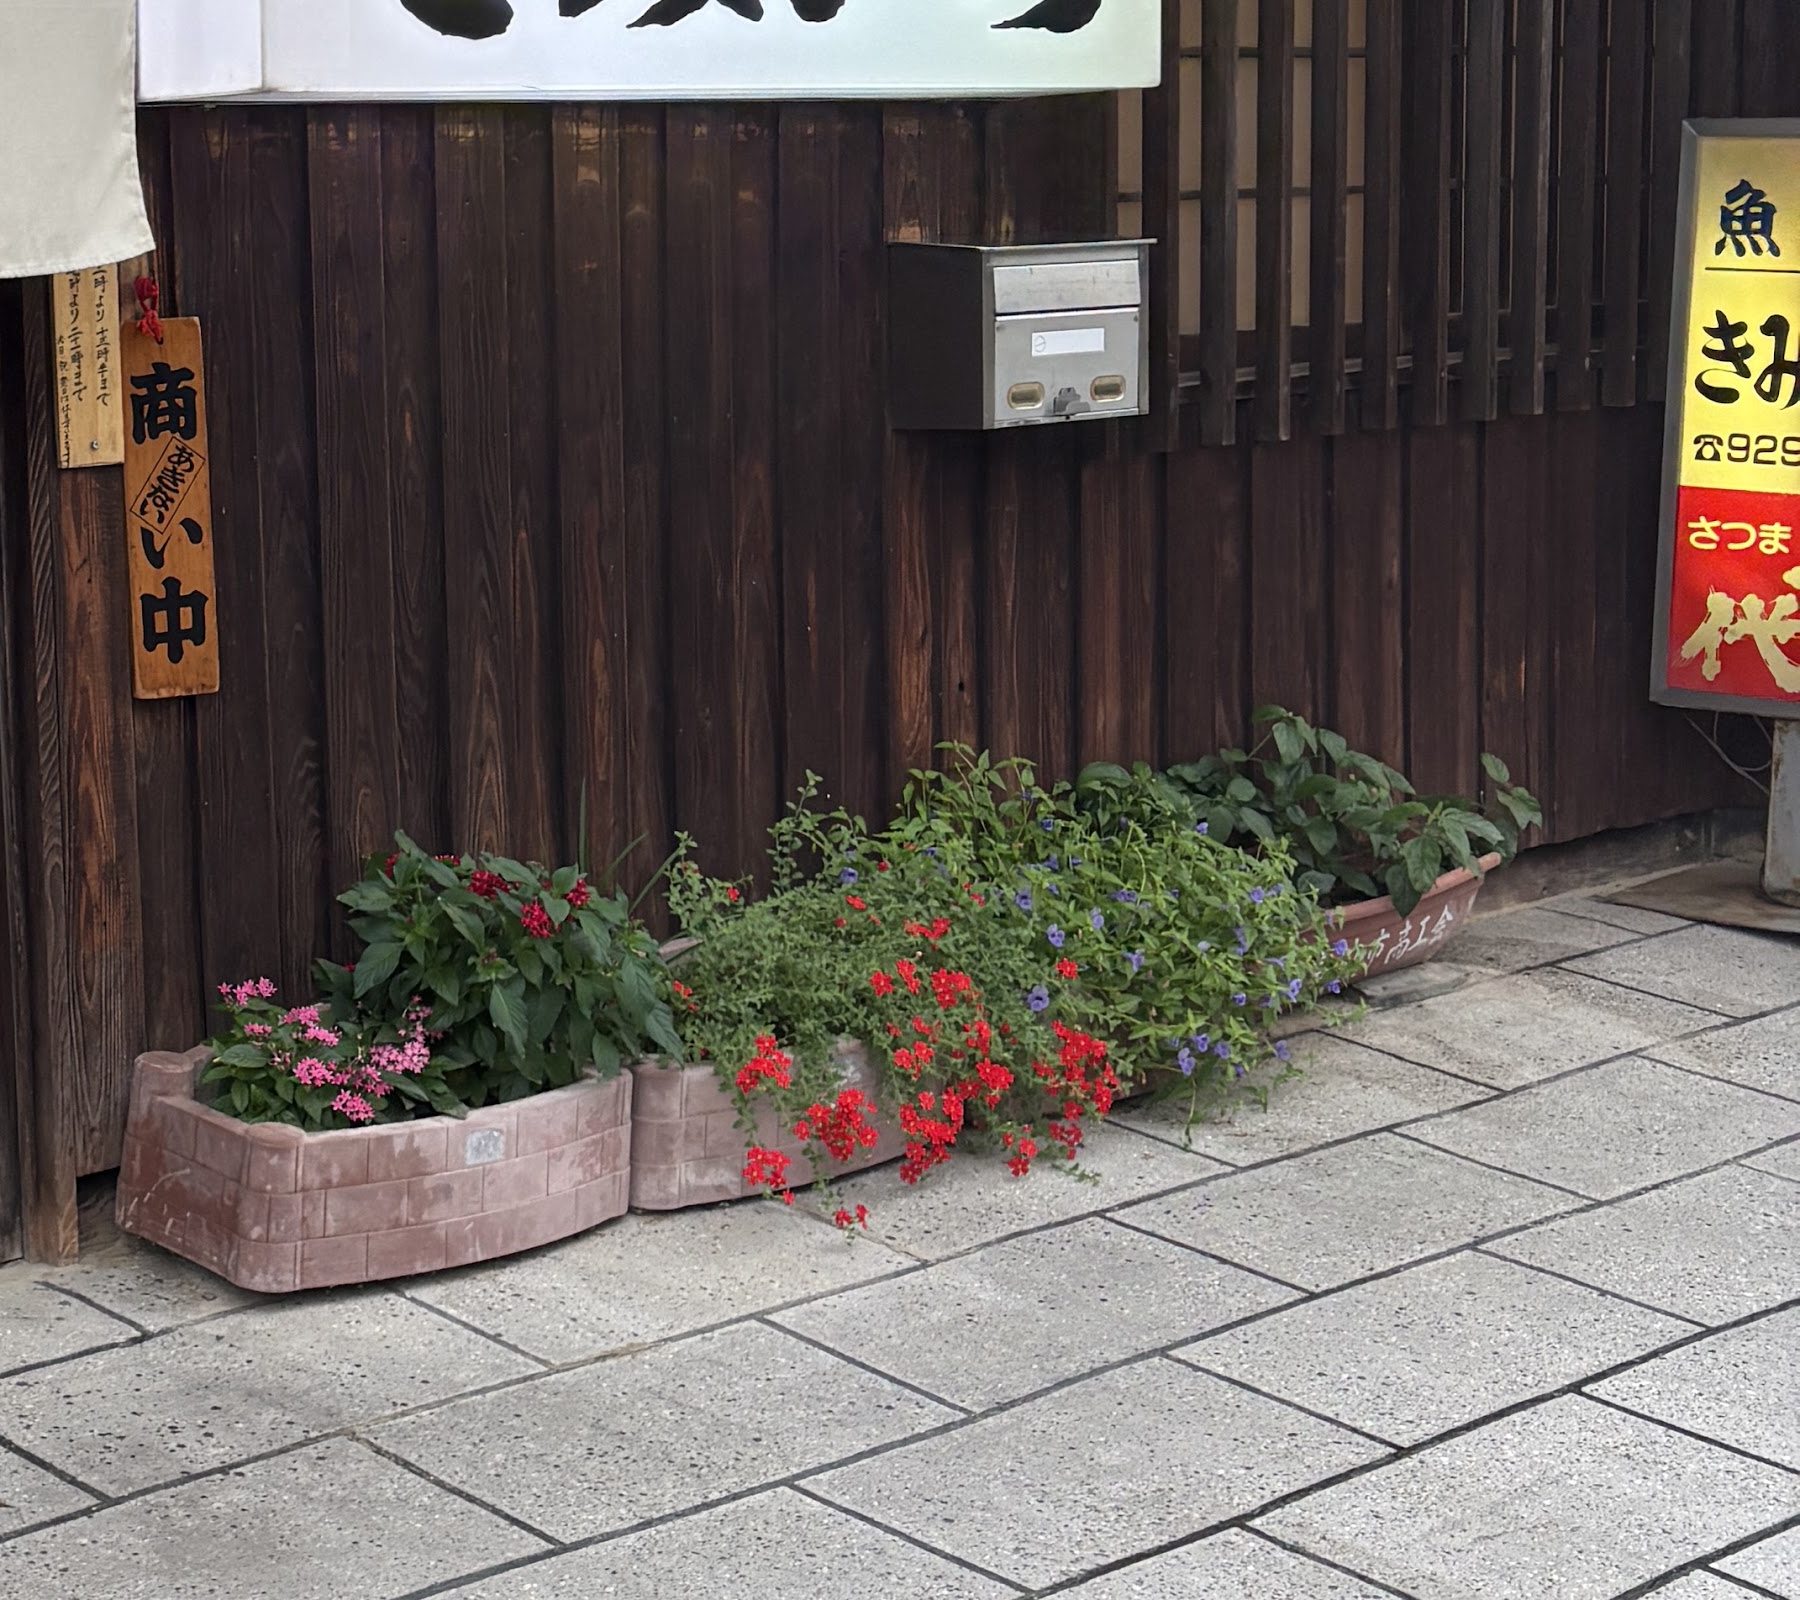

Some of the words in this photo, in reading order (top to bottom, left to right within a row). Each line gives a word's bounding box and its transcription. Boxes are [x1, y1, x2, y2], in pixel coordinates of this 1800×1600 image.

[1715, 179, 1781, 257] 魚
[139, 445, 195, 524] あきない
[1727, 433, 1800, 467] 929
[130, 362, 209, 664] 商い中
[1687, 516, 1792, 554] さつま
